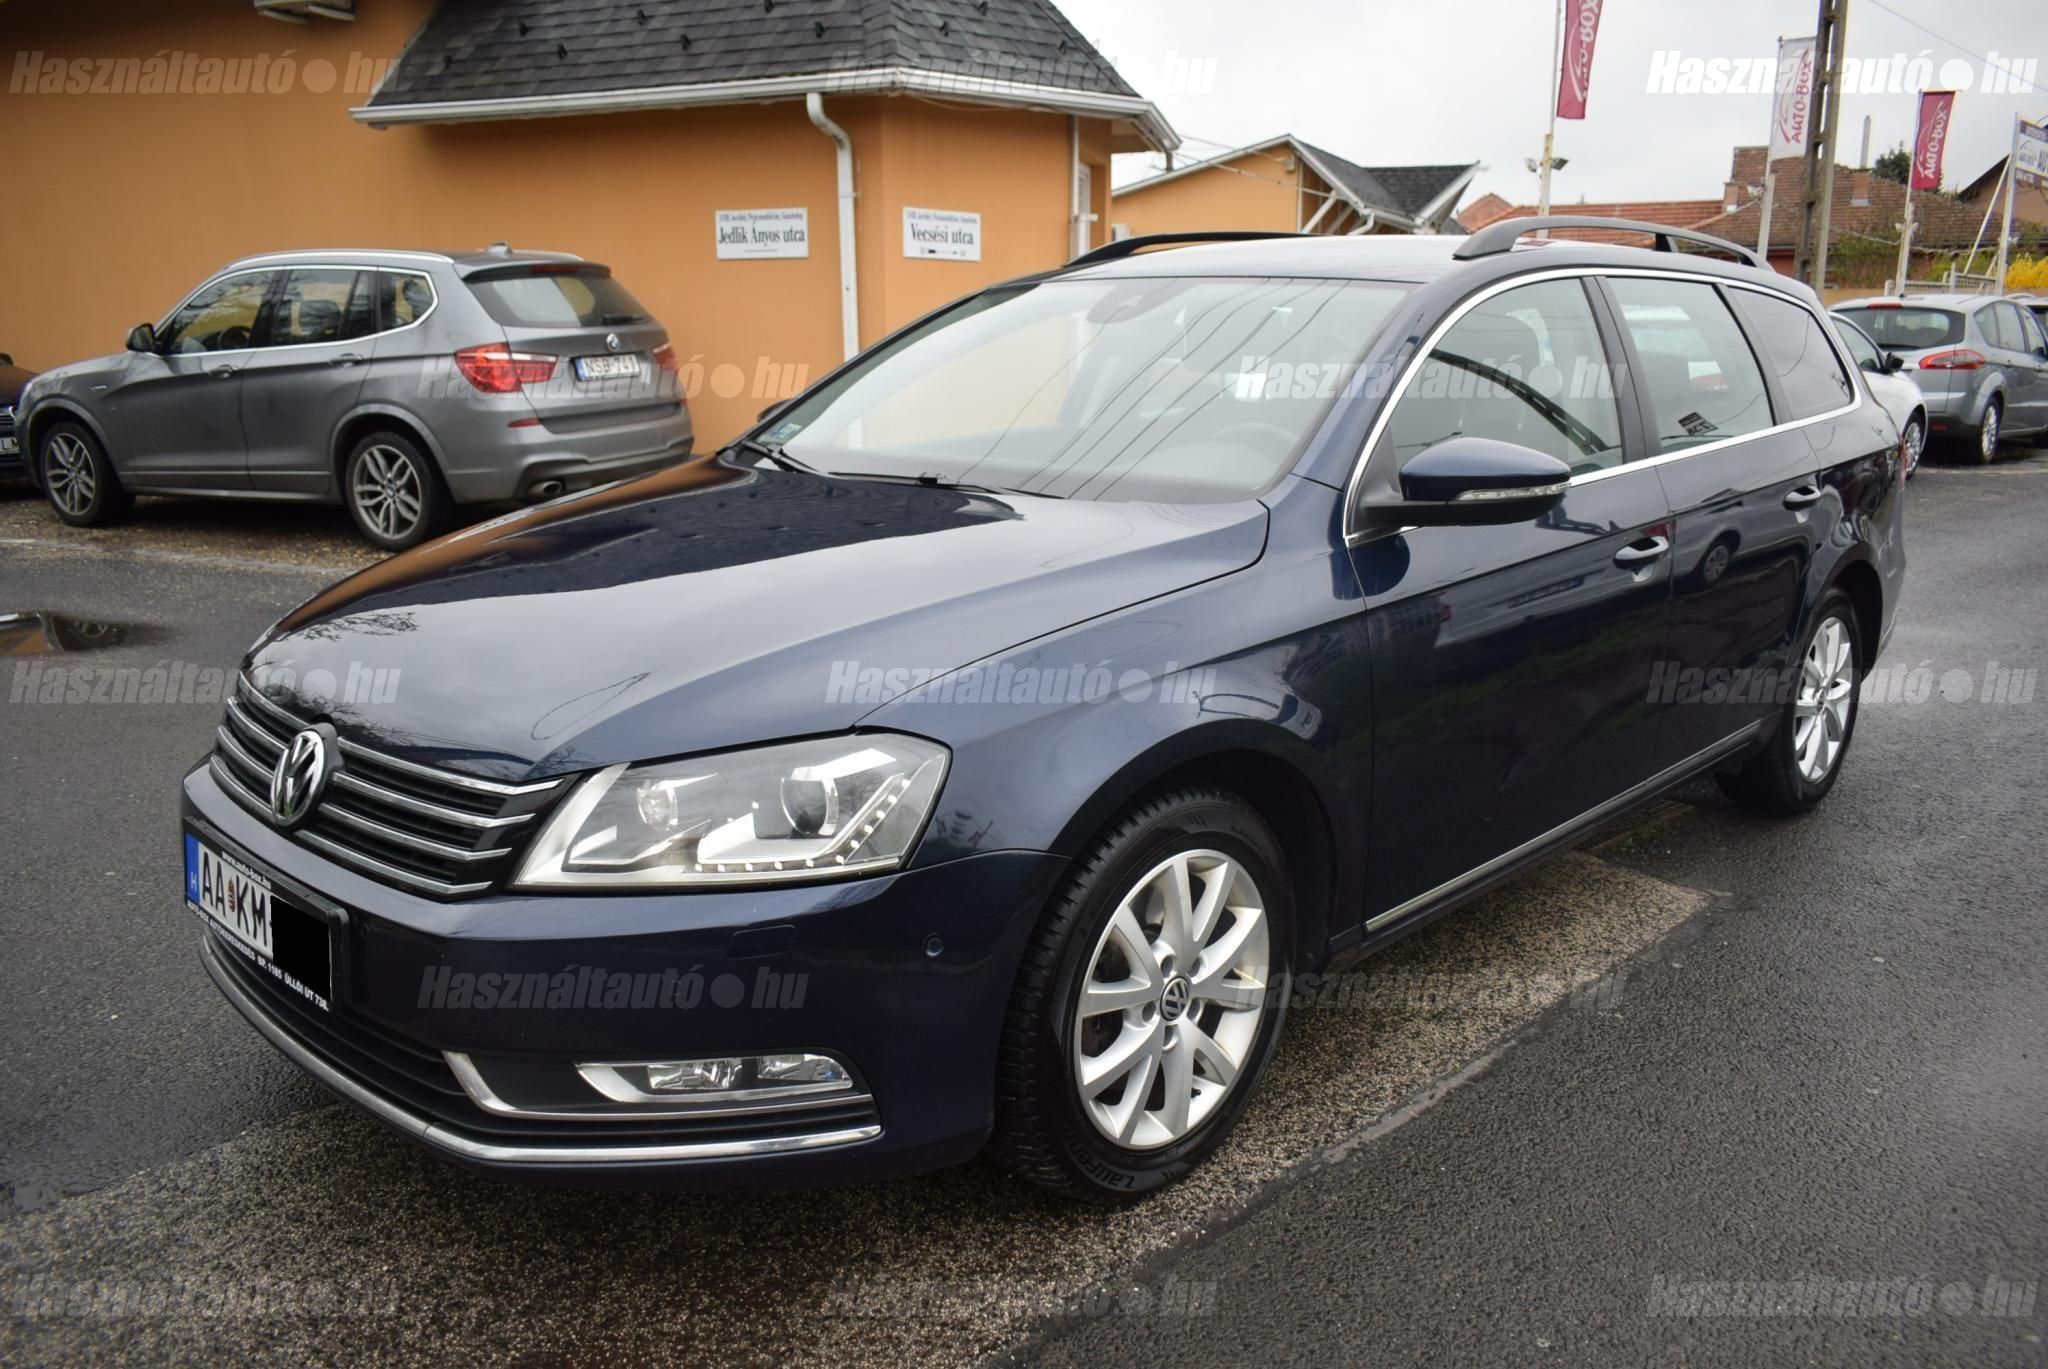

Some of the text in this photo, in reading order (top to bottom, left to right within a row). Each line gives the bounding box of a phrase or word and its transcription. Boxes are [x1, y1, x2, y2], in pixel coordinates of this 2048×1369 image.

[1791, 60, 1812, 143] AUTO-BOX
[1924, 109, 1947, 178] AUTO-BOX
[718, 220, 805, 247] Jedlik Ányos utca
[911, 222, 974, 245] Vecsési utca
